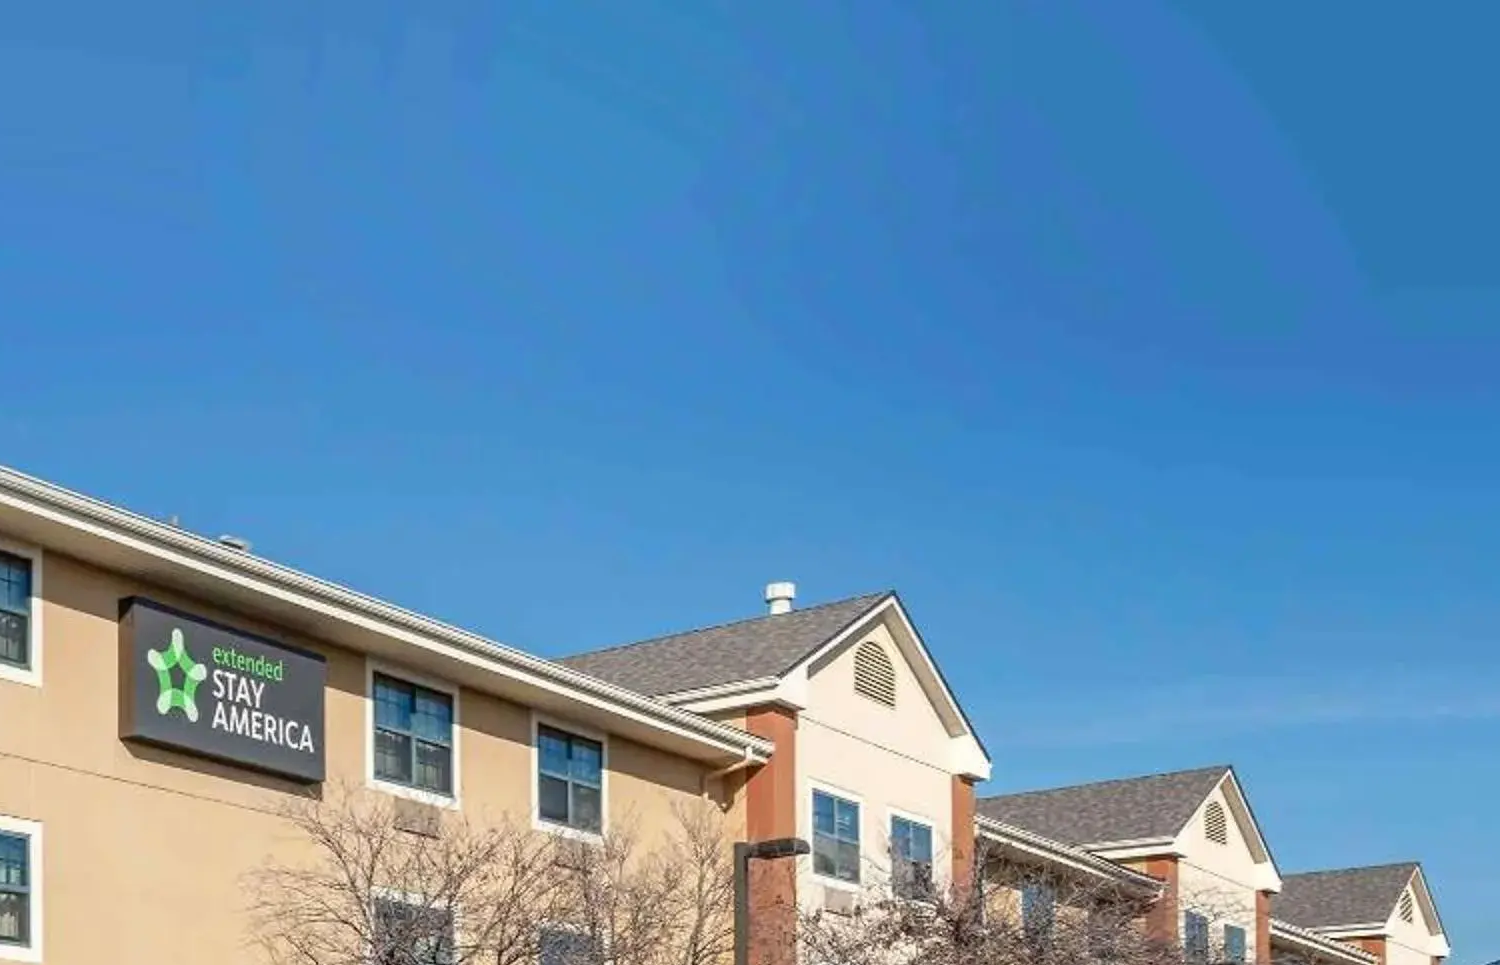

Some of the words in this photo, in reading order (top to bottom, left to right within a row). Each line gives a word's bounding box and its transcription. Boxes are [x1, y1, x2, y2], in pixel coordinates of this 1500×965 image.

[212, 647, 283, 681] extended
[211, 669, 265, 709] STAY
[211, 701, 315, 753] AMERICA
